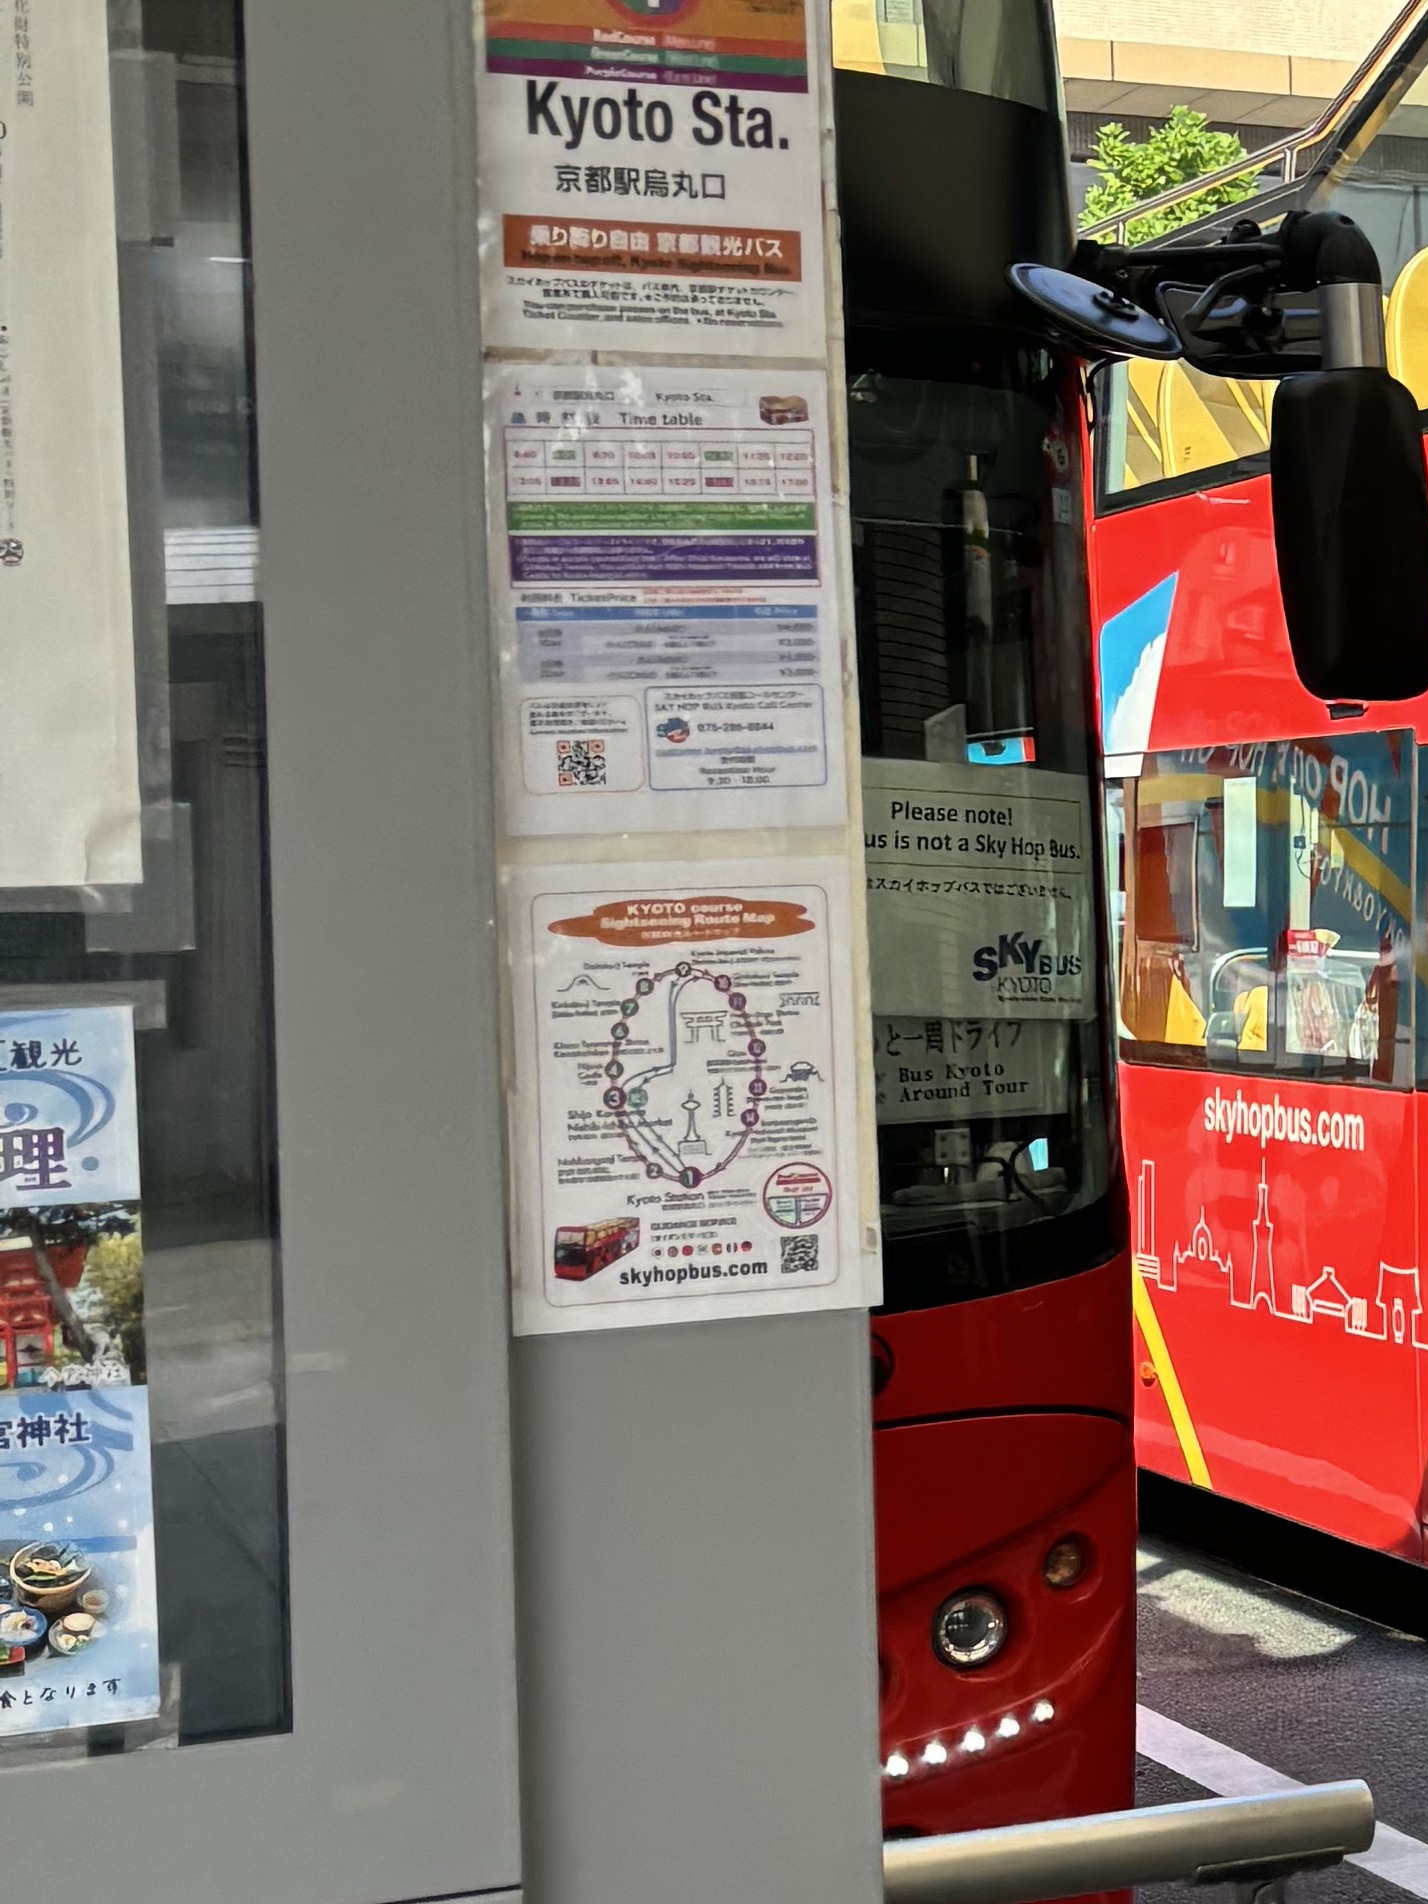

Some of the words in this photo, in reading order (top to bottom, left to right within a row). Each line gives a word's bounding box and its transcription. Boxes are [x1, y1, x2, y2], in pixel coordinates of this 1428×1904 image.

[526, 79, 673, 150] Kyoto
[692, 91, 789, 150] Sta.
[554, 164, 726, 200] 京都駅烏丸口
[891, 801, 958, 822] Please
[965, 807, 1013, 825] note!
[864, 832, 888, 848] us
[894, 830, 910, 849] is
[917, 834, 952, 851] not
[958, 839, 970, 852] a
[975, 834, 1007, 858] Sky
[1011, 837, 1046, 861] Hop
[1050, 839, 1081, 859] Bus.
[627, 903, 686, 915] KYOTO
[972, 931, 1042, 981] SKY
[1039, 955, 1082, 976] BUS
[0, 1038, 83, 1072] 観光
[899, 1067, 934, 1083] Bus
[945, 1061, 1005, 1079] Kyoto
[899, 1081, 971, 1103] Around
[982, 1080, 1029, 1097] Tour
[1204, 1086, 1365, 1151] skyhopbus.com
[620, 1260, 768, 1287] skyhopbus.com
